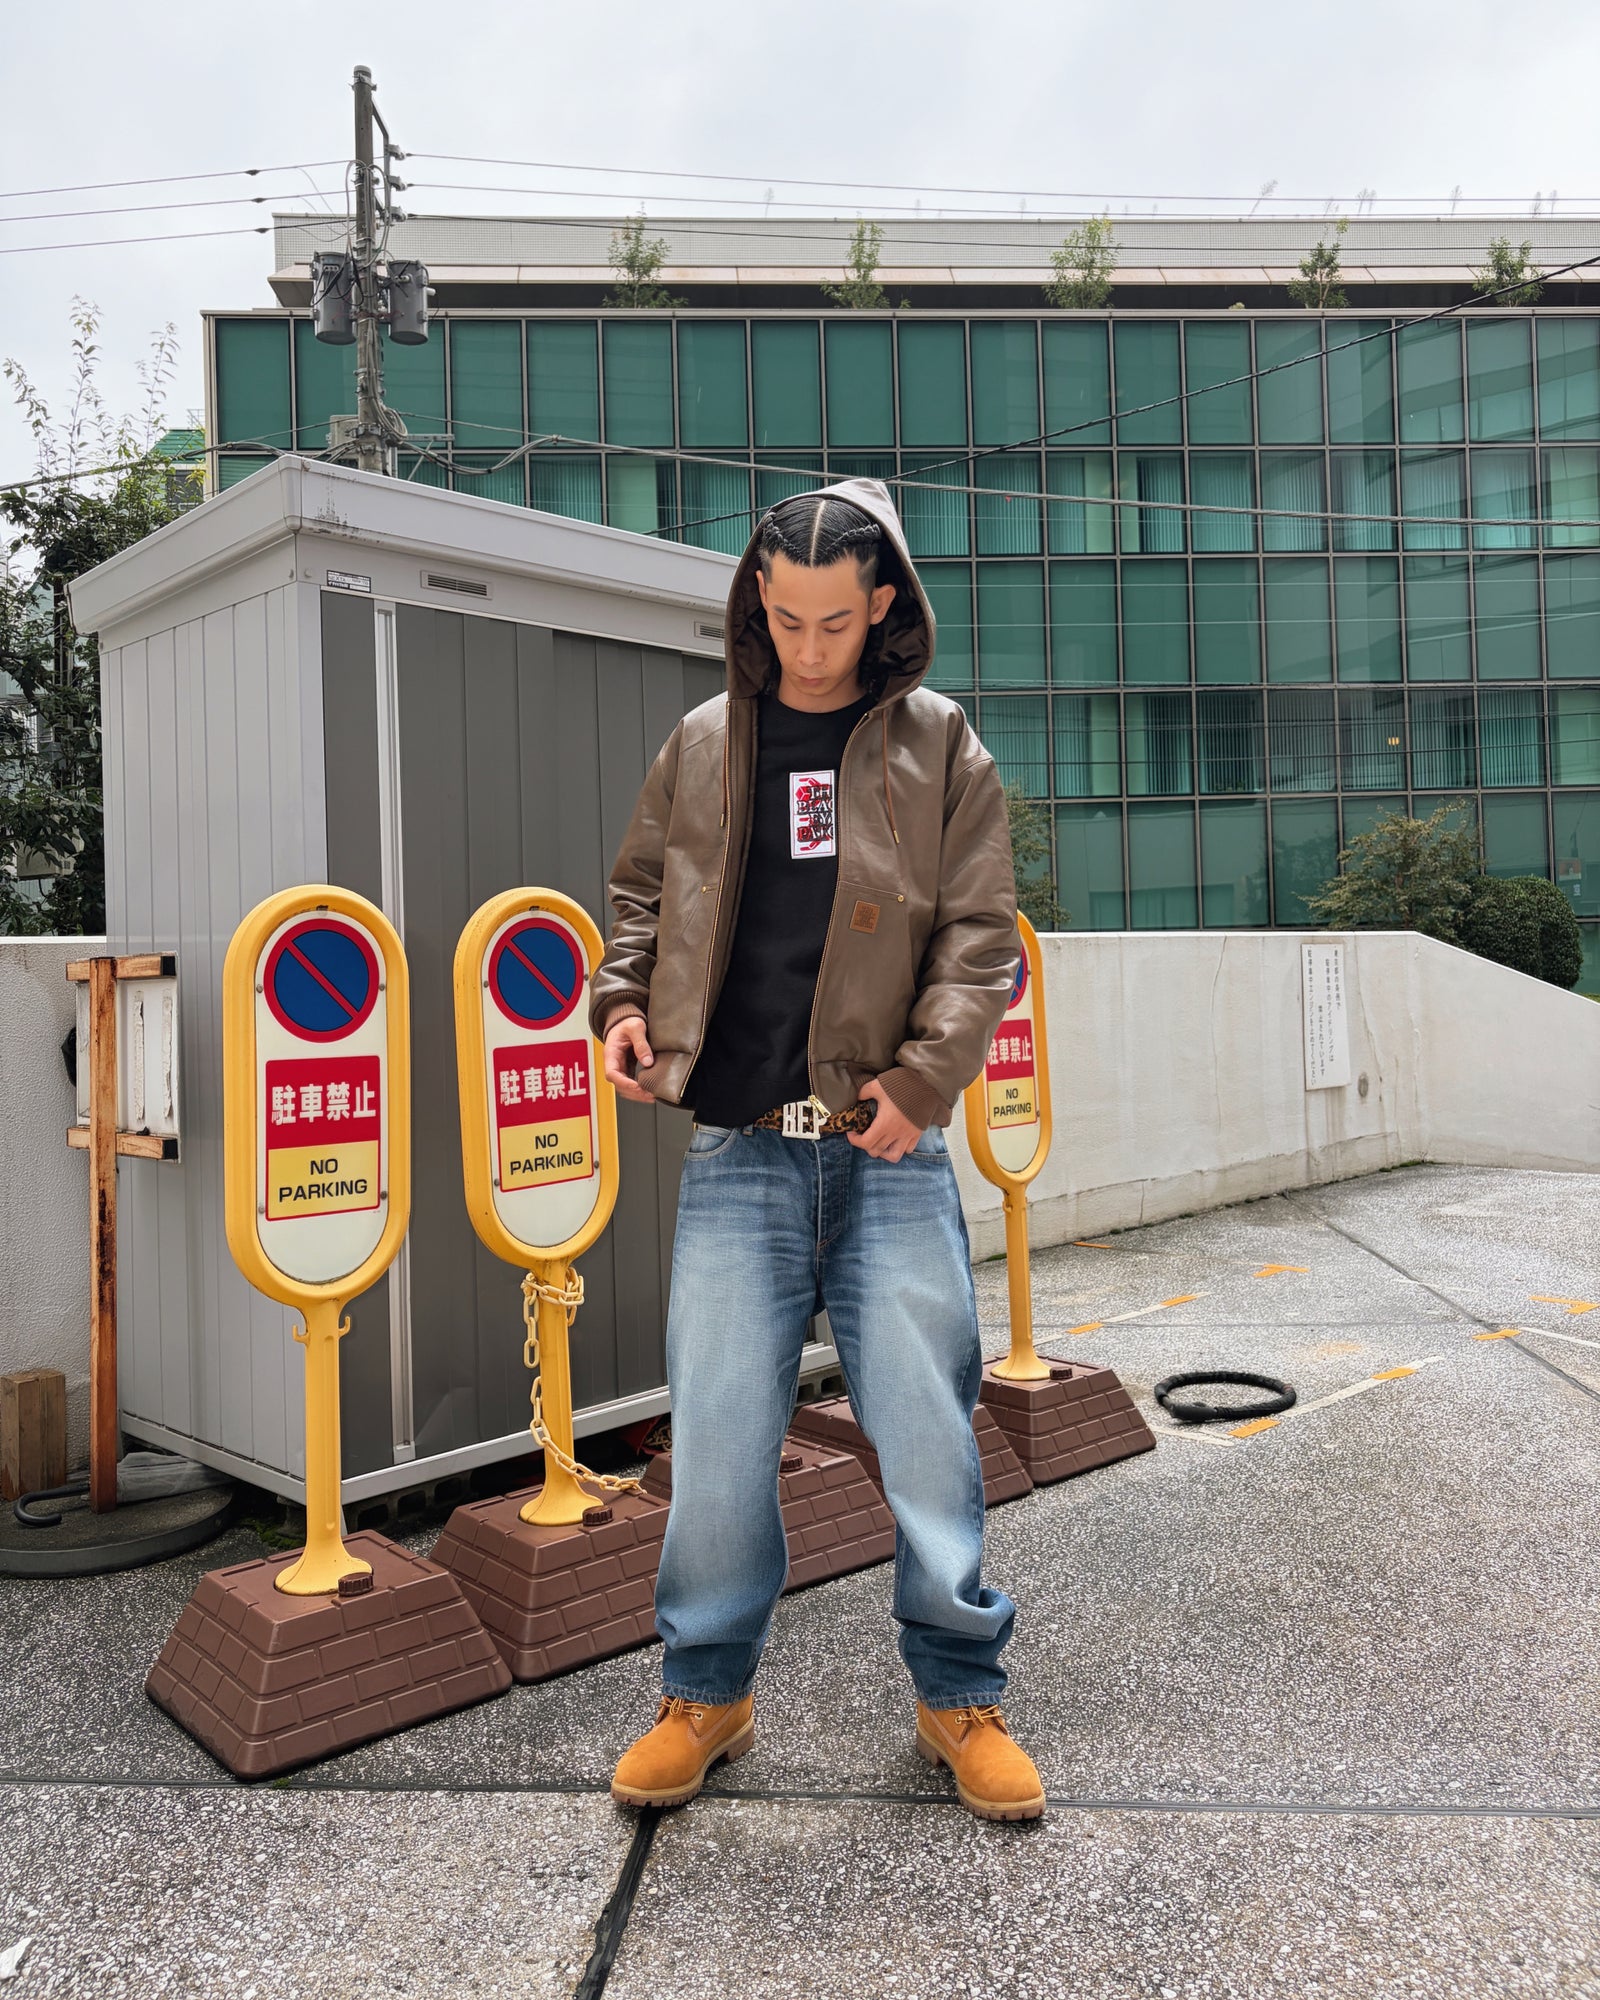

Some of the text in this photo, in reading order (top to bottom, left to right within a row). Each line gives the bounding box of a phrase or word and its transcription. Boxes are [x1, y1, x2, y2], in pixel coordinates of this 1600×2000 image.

[499, 1061, 586, 1106] 駐車禁止
[1005, 1088, 1018, 1099] NO
[271, 1081, 376, 1126] 駐車禁止
[993, 1102, 1031, 1117] PARKING
[535, 1133, 558, 1149] NO
[310, 1158, 338, 1175] NO
[510, 1150, 584, 1175] PARKING
[279, 1178, 367, 1202] PARKING
